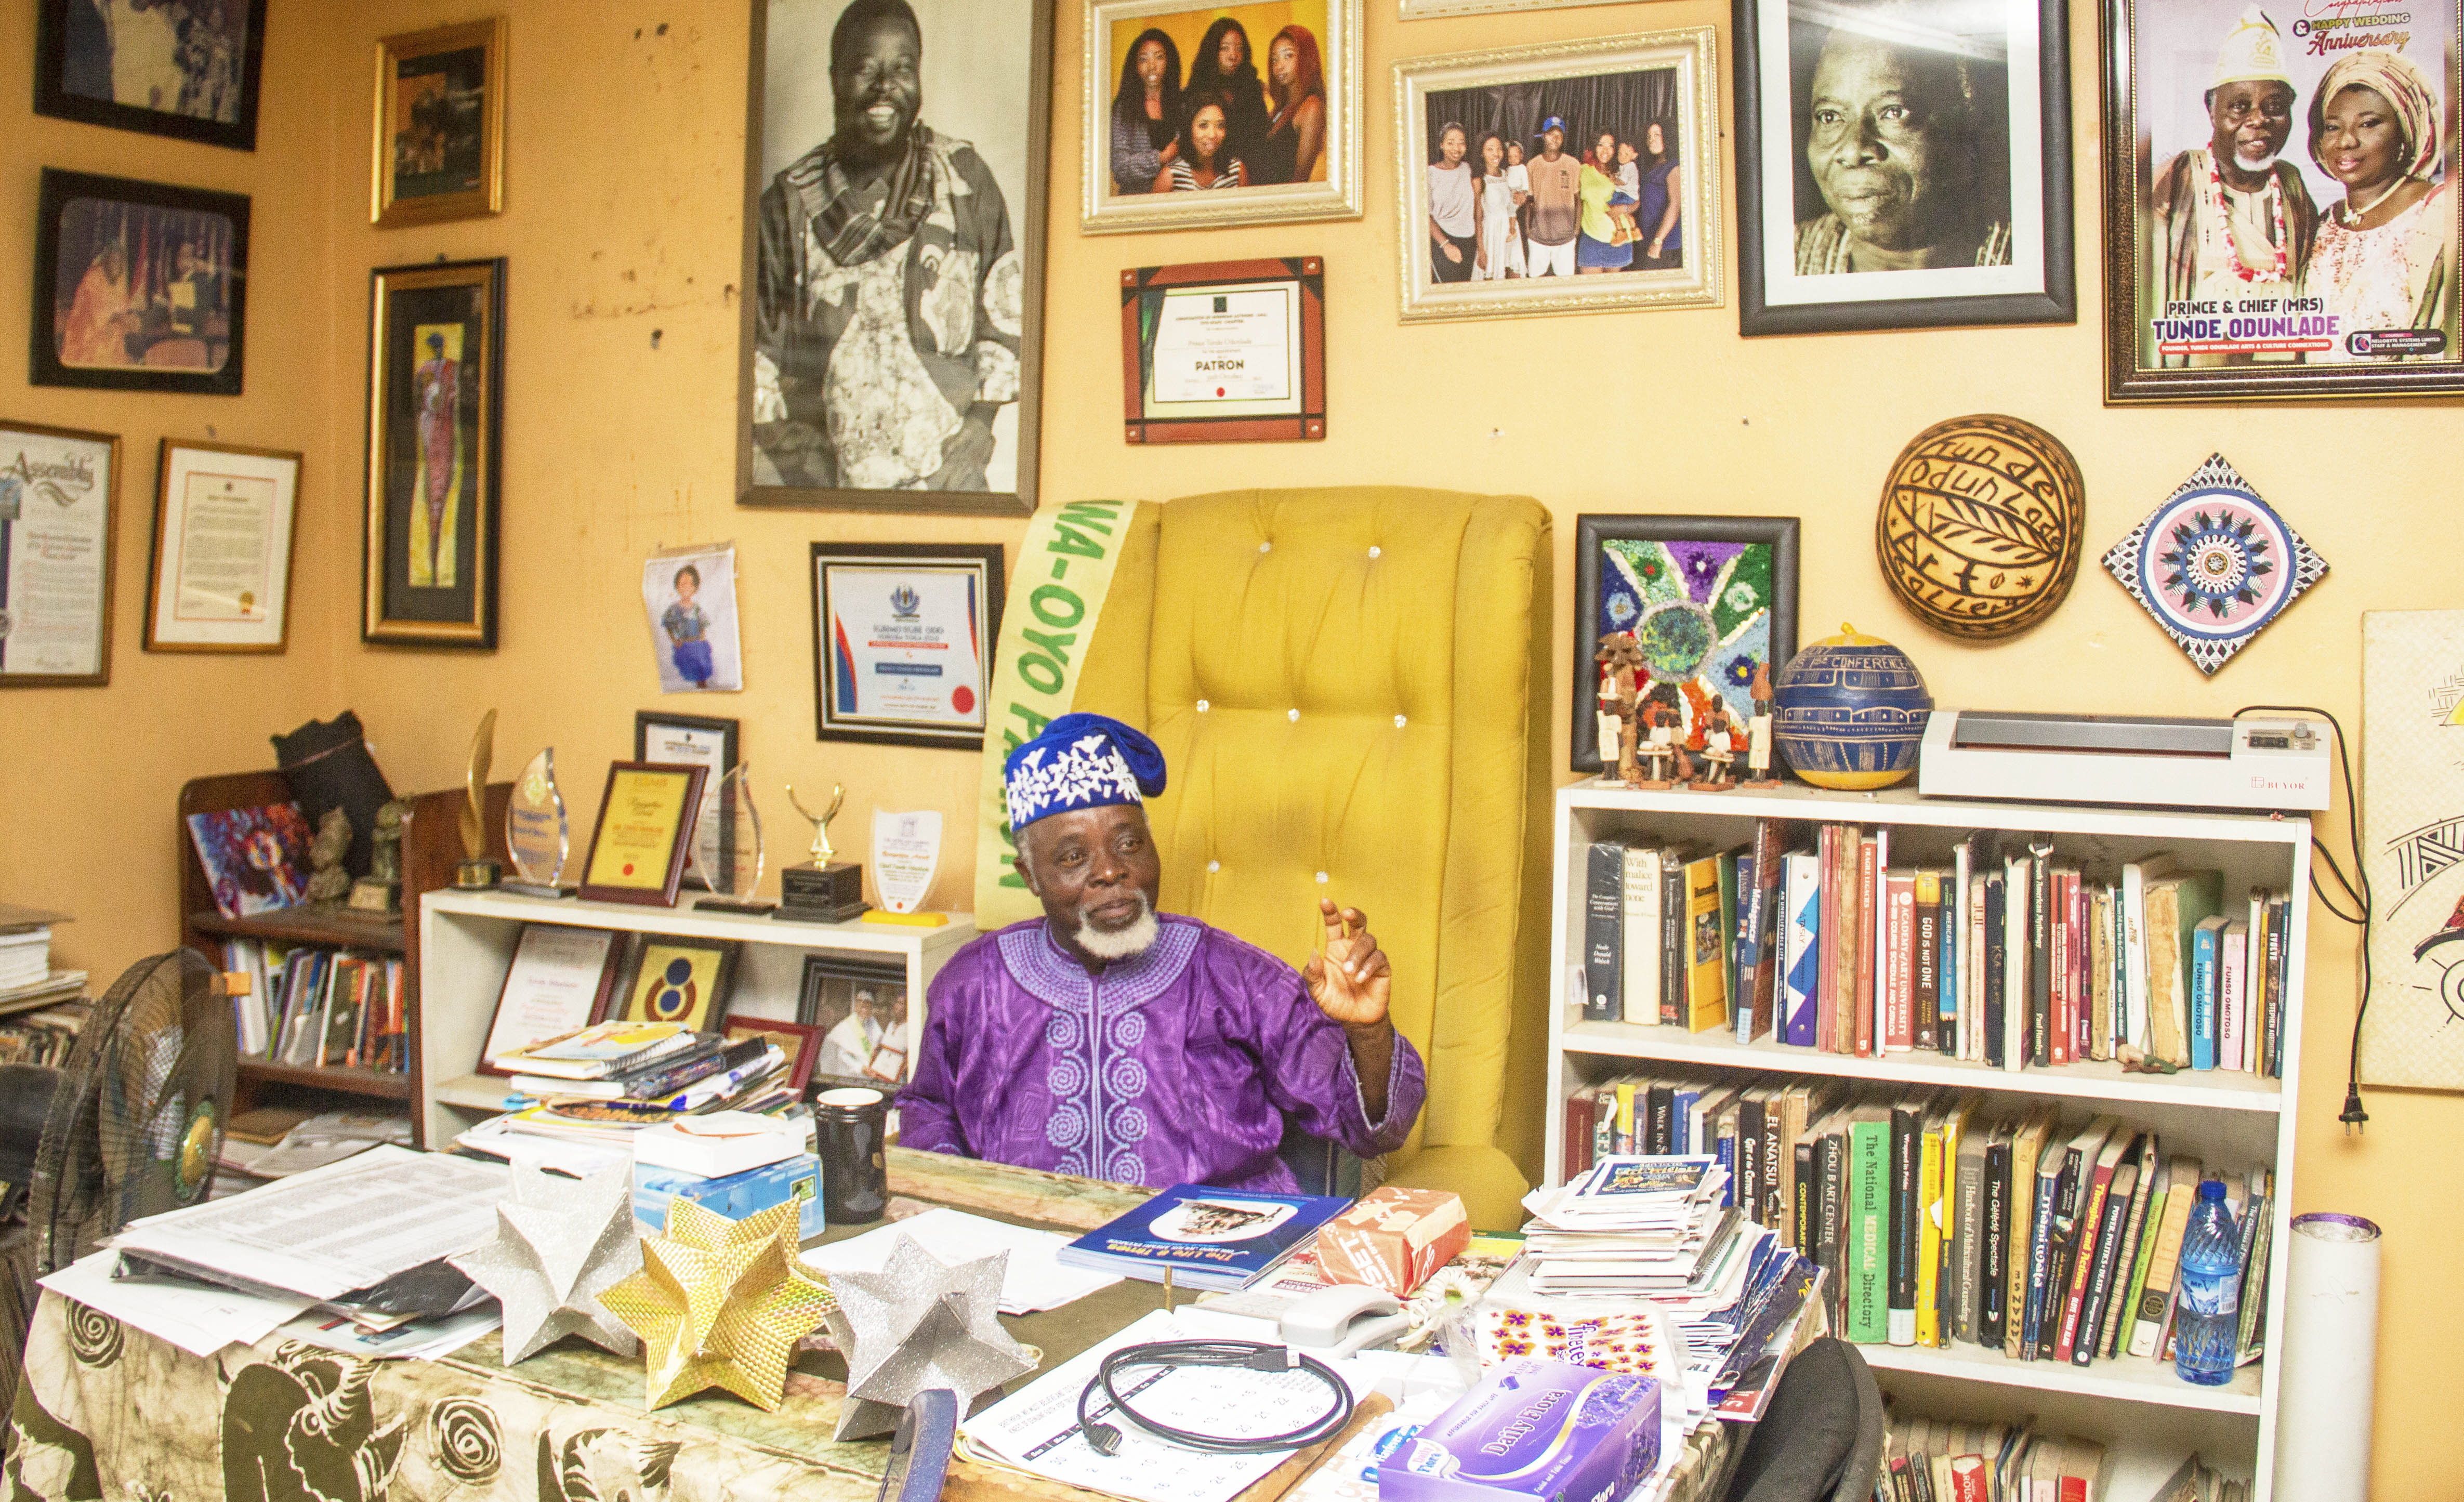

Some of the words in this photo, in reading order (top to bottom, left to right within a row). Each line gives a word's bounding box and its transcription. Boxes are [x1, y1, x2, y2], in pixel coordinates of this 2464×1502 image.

[2312, 18, 2351, 30] HAPPY
[2353, 12, 2410, 27] WEDDING
[2307, 30, 2410, 56] Anniversary
[2168, 300, 2217, 315] PRINCE
[2222, 300, 2234, 313] &
[2239, 299, 2278, 312] CHIEF
[2282, 297, 2323, 314] (MRS)
[2153, 319, 2221, 340] TUNDE
[2229, 315, 2339, 338] ODUNLADE
[1195, 360, 1244, 371] PATRON
[1831, 656, 1908, 670] CONFERENCE
[1625, 857, 1647, 868] With
[1625, 870, 1653, 879] malice
[1625, 882, 1653, 891] toward
[1625, 893, 1645, 902] none
[1749, 889, 1761, 944] Madagascar
[1974, 903, 1983, 931] JUJU
[1901, 907, 1909, 951] ACADEMY
[1922, 917, 1932, 938] GOD
[2269, 933, 2278, 960] EVOLVE
[1922, 949, 1930, 966] NOT
[1900, 960, 1908, 979] ART
[1921, 967, 1932, 988] ONE
[1899, 980, 1907, 1036] UNIVERSITY
[2035, 1029, 2043, 1056] Hamlyn
[1767, 1116, 1778, 1128] EL
[1656, 1133, 1663, 1143] IN
[1866, 1135, 1878, 1152] The
[1766, 1132, 1778, 1185] ANATSUI
[1828, 1140, 1838, 1171] ZHOU
[1827, 1181, 1836, 1202] ART
[1865, 1161, 1877, 1210] National
[1992, 1180, 2000, 1197] The
[1965, 1184, 1977, 1223] Handbook
[2088, 1183, 2106, 1229] Thoughts
[2149, 1205, 2160, 1220] Weep
[1825, 1205, 1835, 1243] CENTER
[1965, 1223, 1975, 1232] of
[2107, 1205, 2120, 1233] POWER,
[2147, 1221, 2156, 1232] Not
[1864, 1215, 1877, 1271] MEDICAL
[2083, 1231, 2093, 1251] and
[2101, 1233, 2114, 1264] POLITICS
[1962, 1233, 1974, 1281] Multicultural
[1989, 1233, 1999, 1276] Spectacle
[2074, 1251, 2091, 1289] Actions
[2094, 1268, 2106, 1293] DEATH
[1860, 1273, 1875, 1328] Directory
[1509, 1360, 1532, 1376] Extra
[1526, 1365, 1544, 1376] Soft
[1481, 1419, 1536, 1456] Daily
[1518, 1389, 1568, 1421] Flora
[1412, 1446, 1433, 1463] Daily
[1416, 1453, 1442, 1473] Flora
